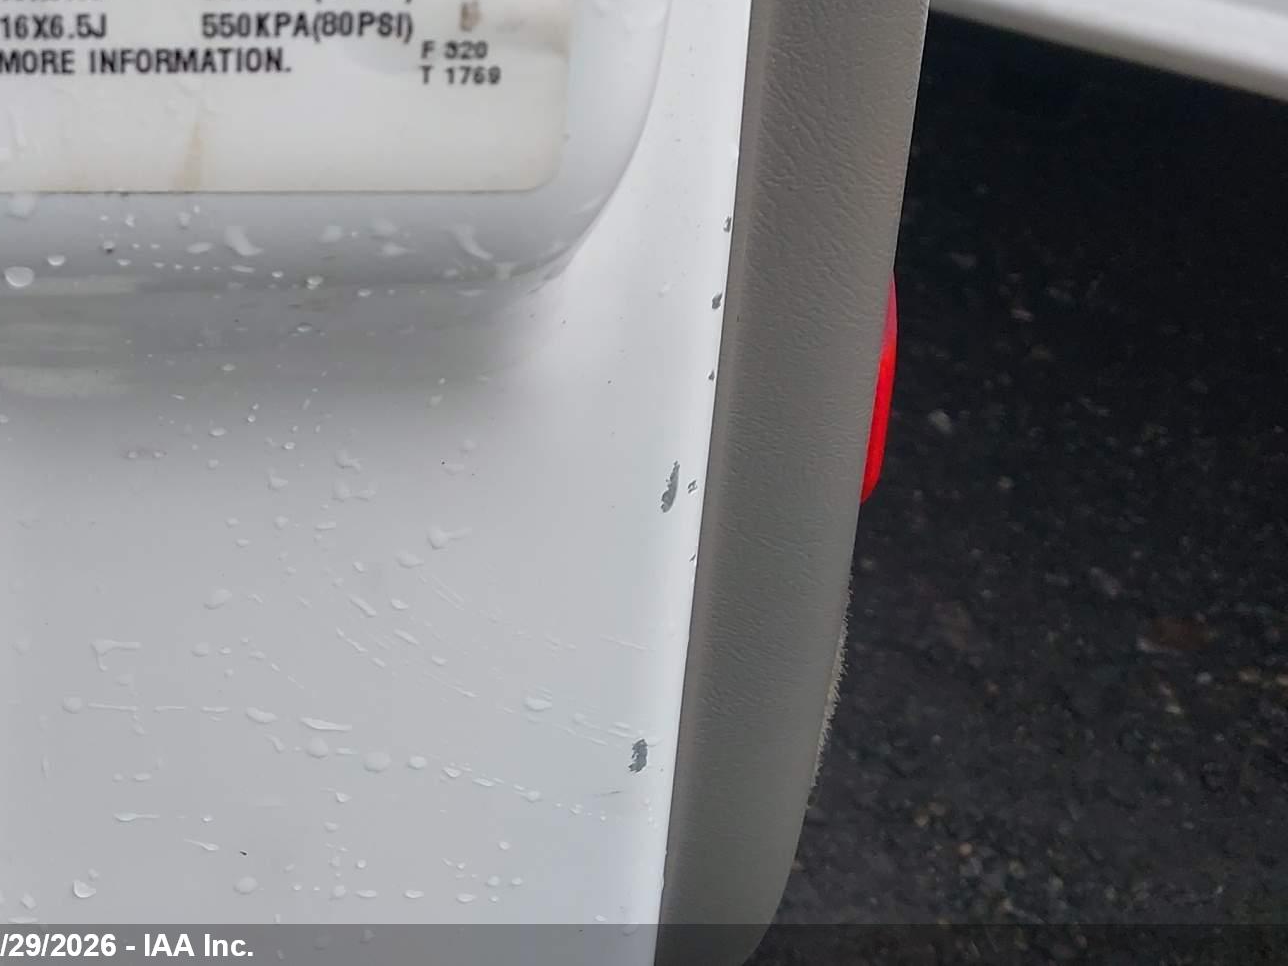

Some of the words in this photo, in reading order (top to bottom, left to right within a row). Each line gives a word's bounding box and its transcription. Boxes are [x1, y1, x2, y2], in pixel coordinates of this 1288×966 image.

[0, 13, 107, 41] 16X6.5J
[201, 12, 414, 45] 550KPA(80PSI)
[89, 47, 292, 74] INFORMATION.
[422, 41, 435, 60] F
[421, 67, 436, 85] T
